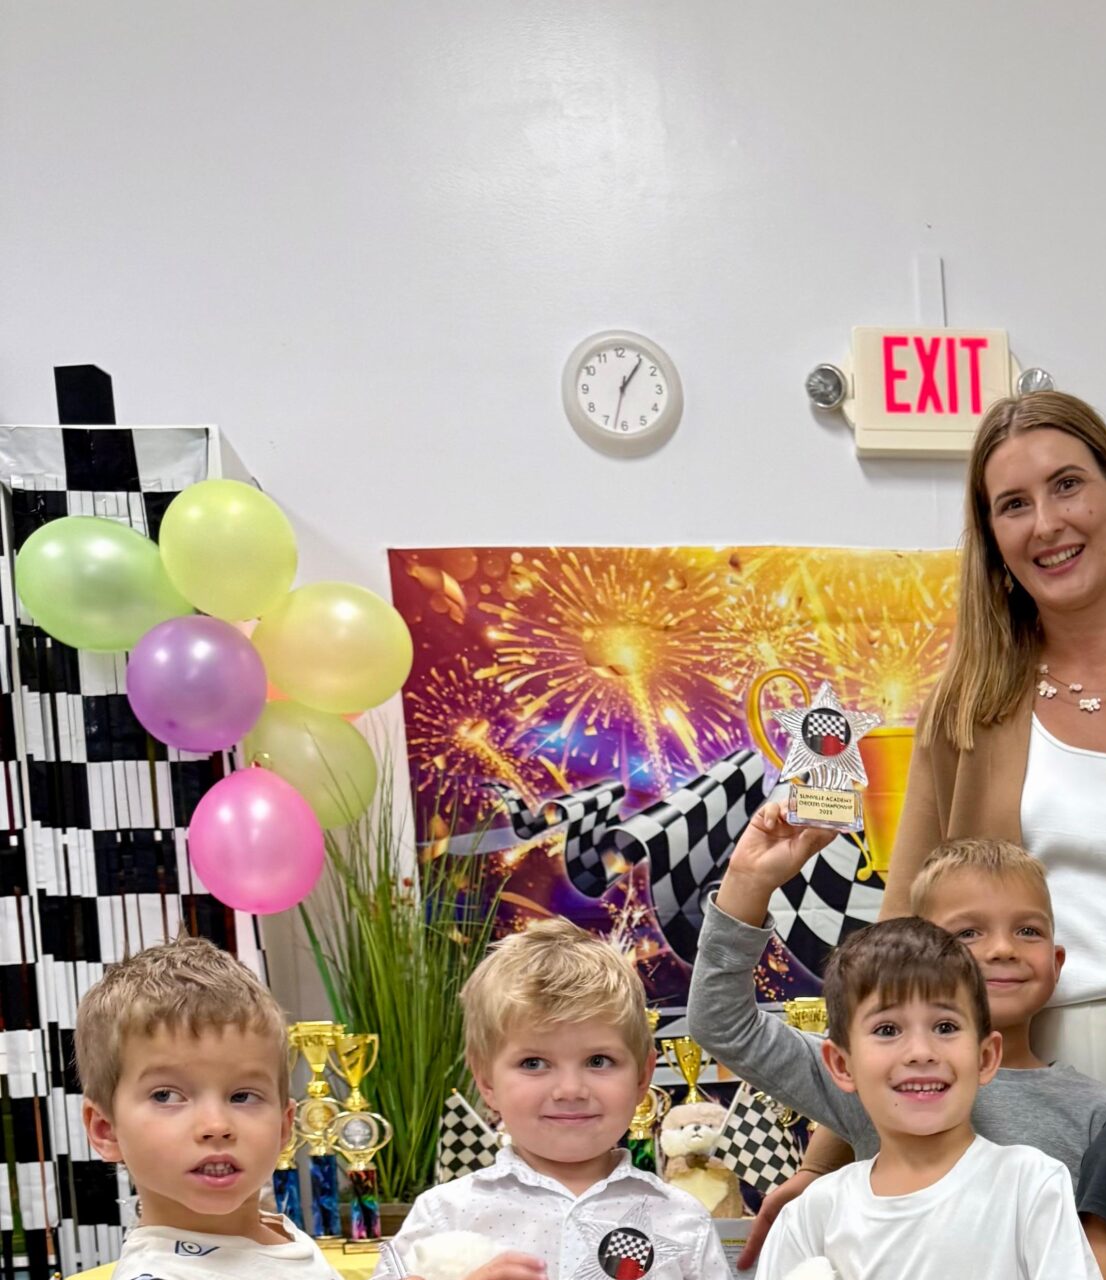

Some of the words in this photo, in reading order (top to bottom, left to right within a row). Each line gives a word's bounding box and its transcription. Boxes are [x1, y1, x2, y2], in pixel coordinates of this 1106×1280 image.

[597, 353, 608, 363] 11
[614, 347, 626, 358] 12
[585, 365, 597, 377] 10
[649, 366, 657, 377] 2
[883, 335, 988, 414] EXIT
[581, 383, 590, 395] 9
[655, 384, 664, 395] 3
[587, 402, 596, 413] 8
[651, 403, 660, 412] 4
[603, 415, 611, 426] 7
[639, 415, 648, 426] 5
[621, 421, 629, 432] 6
